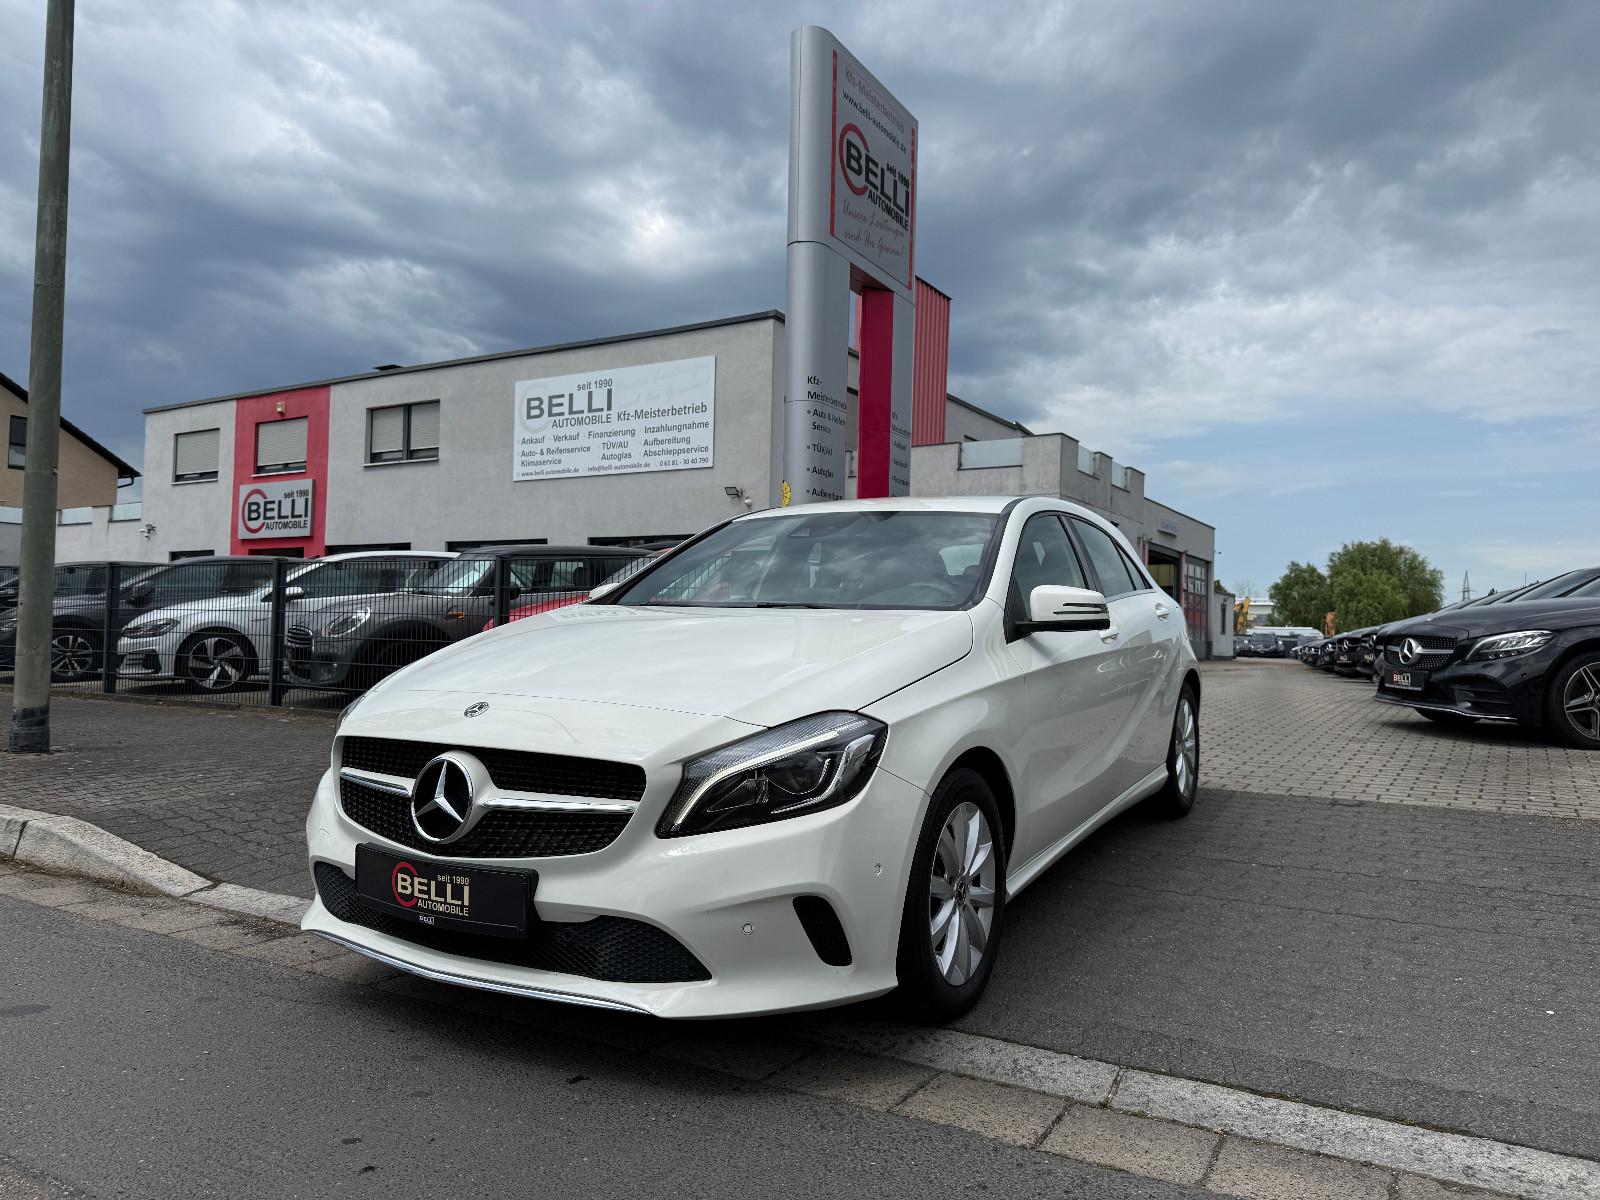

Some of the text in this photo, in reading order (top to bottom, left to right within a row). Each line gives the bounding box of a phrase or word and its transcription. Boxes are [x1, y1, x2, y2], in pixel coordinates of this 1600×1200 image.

[846, 138, 910, 218] BELLI
[886, 163, 897, 178] seit
[868, 190, 909, 232] AUTOMOBILE
[577, 381, 592, 391] seit
[594, 378, 613, 389] 1990
[526, 388, 613, 420] BELLI
[551, 402, 708, 429] AUTOMOBILE Kfz-Meisterbetrieb
[521, 420, 710, 446] Ankauf Verkauf Finanzierung Inzahlungnahme
[521, 449, 538, 457] Auto-
[546, 445, 591, 456] Reifenservice
[602, 440, 629, 450] TÜV/AU
[643, 436, 691, 447] Aufbereitung
[521, 445, 709, 467] Klimaservice Autoglas Abschleppservice
[284, 489, 309, 499] seit 1990
[247, 498, 309, 521] BELLI
[265, 520, 308, 530] AUTOMOBILE
[397, 873, 470, 906] BELLI
[437, 874, 470, 885] seit 1990
[417, 899, 469, 916] AUTOMOBILE
